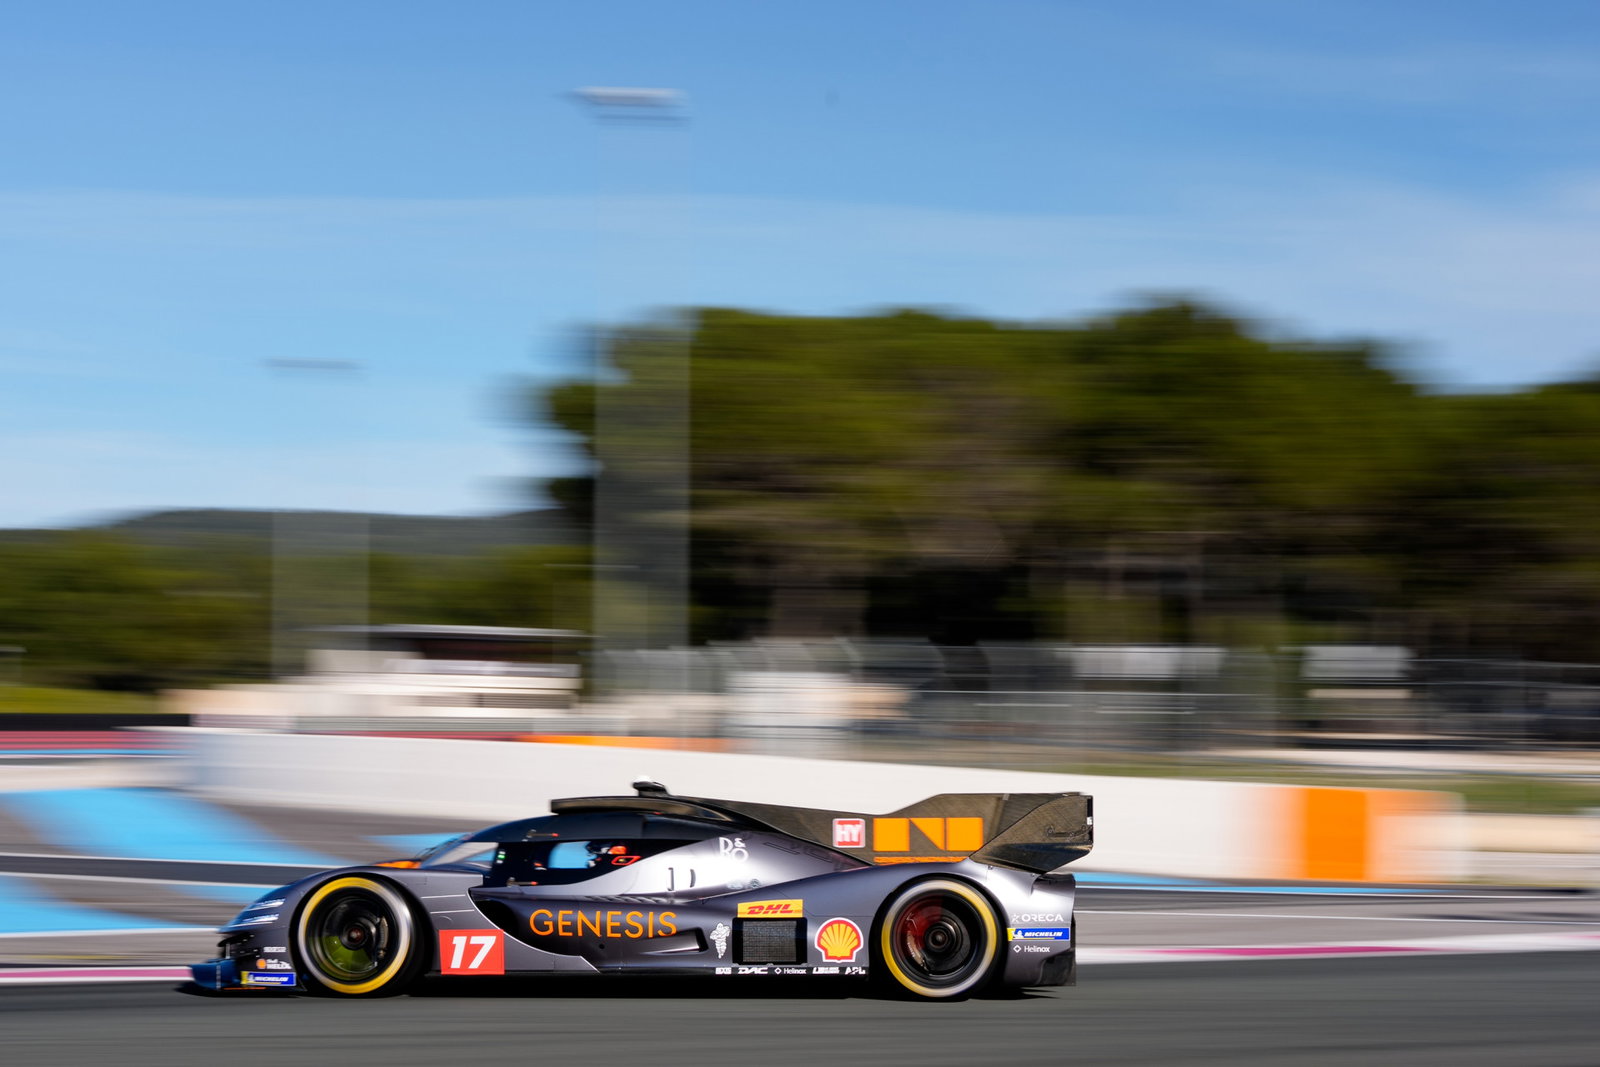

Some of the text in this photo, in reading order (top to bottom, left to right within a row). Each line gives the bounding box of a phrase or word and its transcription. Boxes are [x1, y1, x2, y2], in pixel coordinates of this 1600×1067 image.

[747, 904, 794, 915] DHL
[1021, 913, 1064, 922] ORECA
[529, 908, 677, 938] GENESIS
[450, 935, 497, 969] 17
[1024, 945, 1050, 953] Helinox
[783, 967, 806, 975] Helinox
